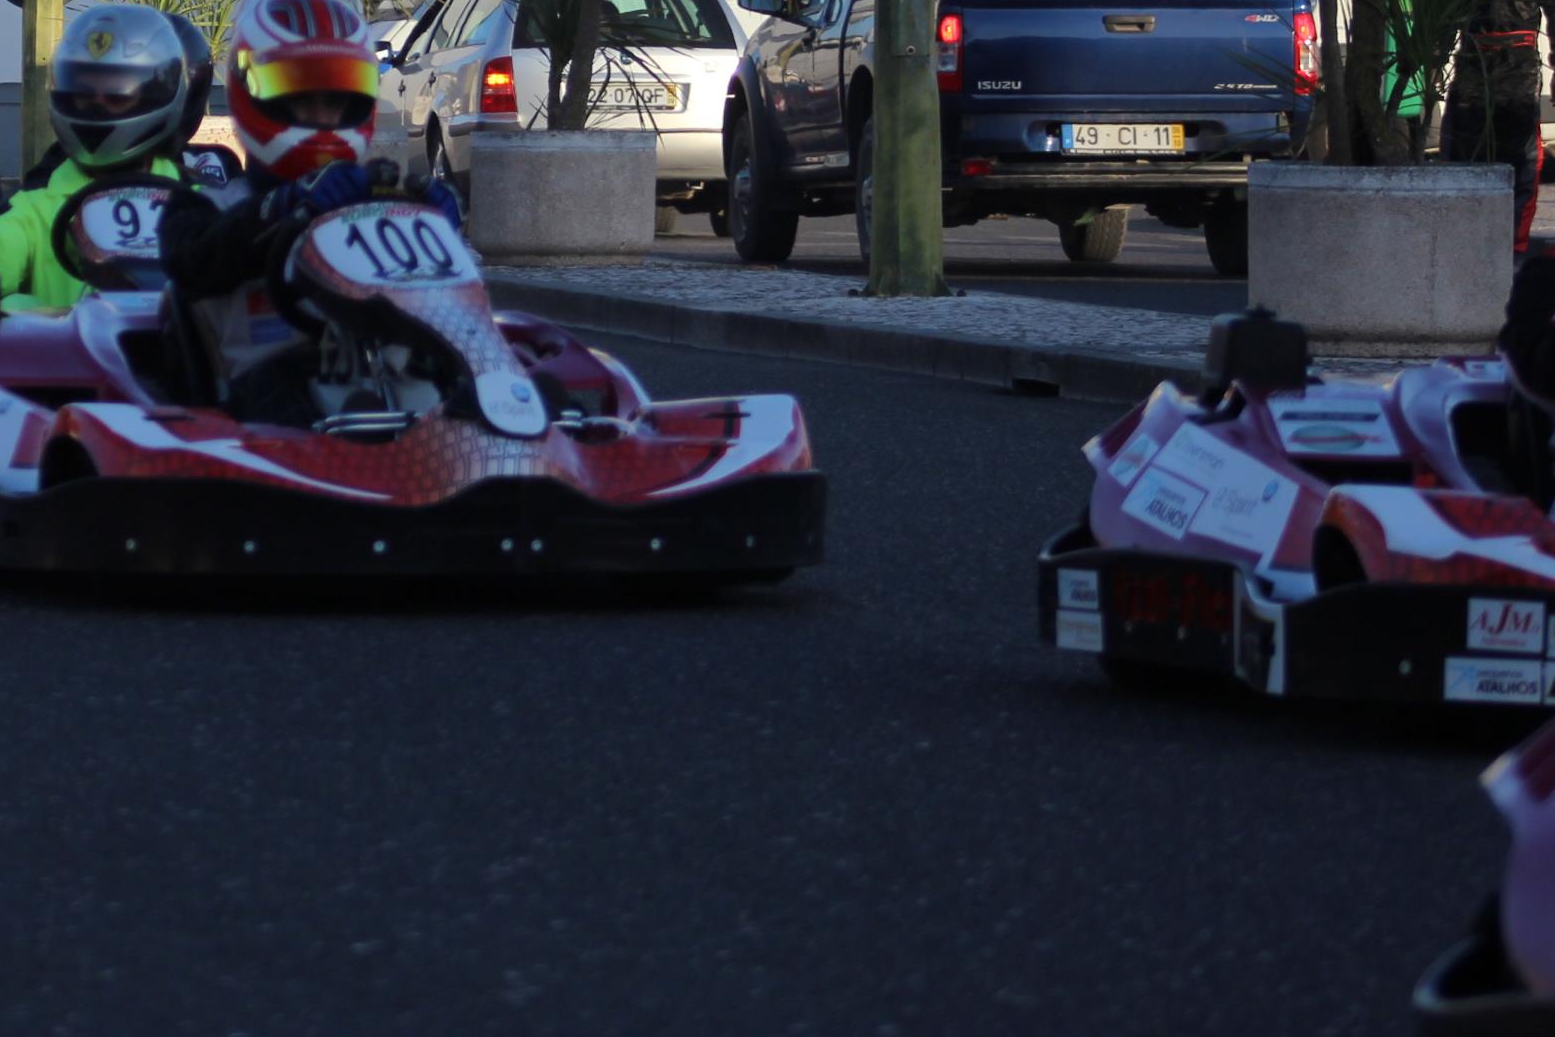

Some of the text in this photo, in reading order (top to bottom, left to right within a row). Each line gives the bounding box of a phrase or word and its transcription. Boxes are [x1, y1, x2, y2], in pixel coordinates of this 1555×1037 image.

[978, 80, 1022, 90] ISUZU
[346, 217, 454, 278] 100
[1476, 679, 1538, 695] ATALHOS
